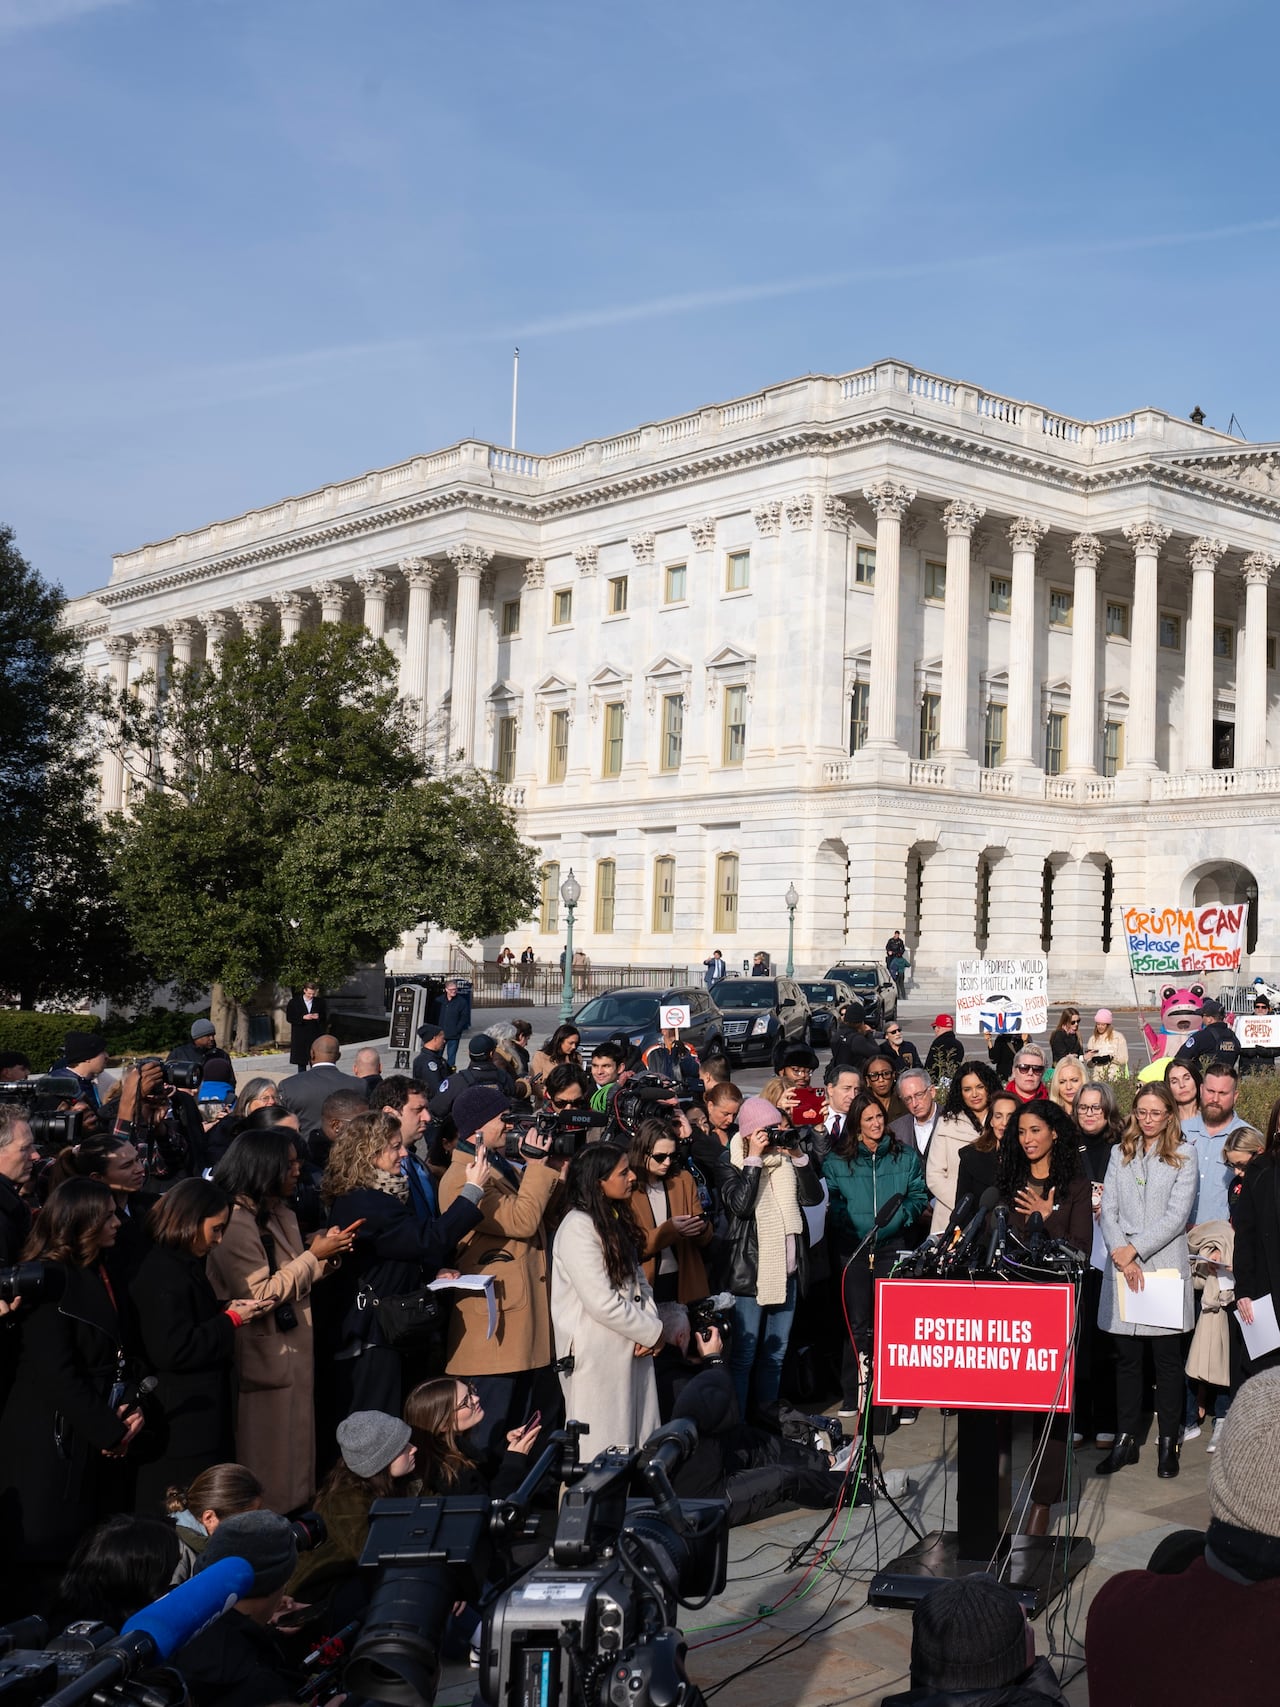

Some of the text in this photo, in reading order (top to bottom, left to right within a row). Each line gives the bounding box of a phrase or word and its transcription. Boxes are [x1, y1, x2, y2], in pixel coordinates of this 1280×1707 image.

[1198, 905, 1243, 937] CAN
[1129, 931, 1227, 955] Release ALL
[959, 960, 979, 974] WHICH
[1019, 960, 1044, 974] WOULD
[959, 977, 978, 991] JESUS
[957, 994, 986, 1011] RELEASE
[1024, 994, 1049, 1011] EPSTEIN
[960, 1014, 972, 1026] THE
[1025, 1012, 1048, 1029] FILES
[914, 1317, 1032, 1344] EPSTEIN FILES
[888, 1344, 1059, 1372] TRANSPARENCY ACT
